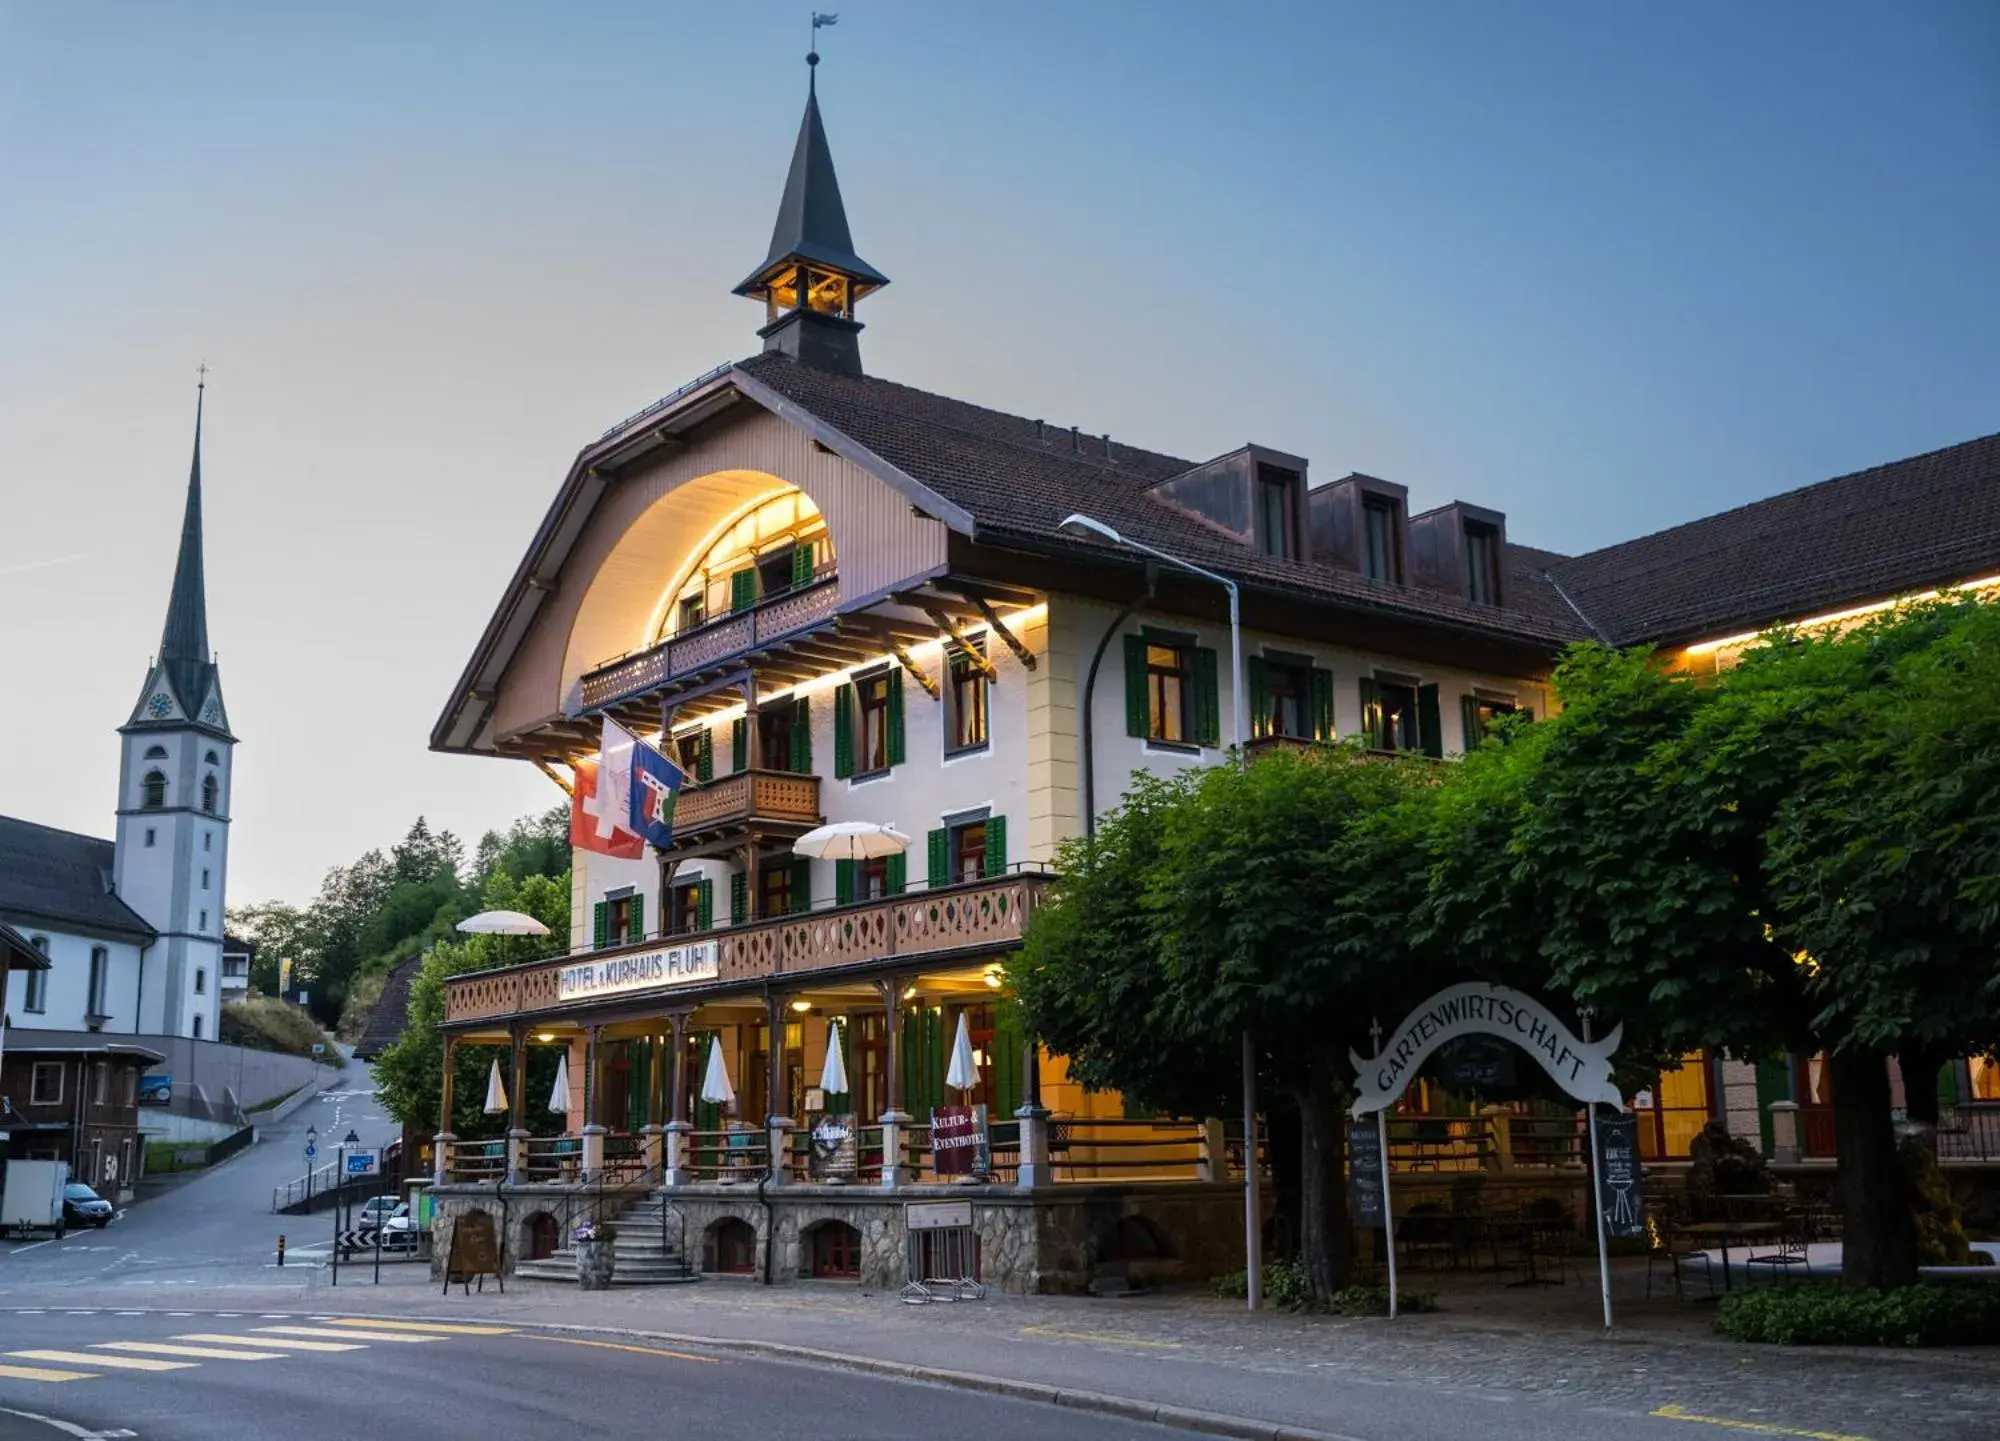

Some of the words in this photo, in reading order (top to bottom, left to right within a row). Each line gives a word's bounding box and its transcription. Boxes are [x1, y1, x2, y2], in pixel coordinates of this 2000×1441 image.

[561, 965, 598, 995] HOTEL
[606, 953, 663, 987] KURHAUS
[1377, 994, 1585, 1092] GARTENWIRTSCHAFT
[935, 1133, 986, 1151] EVENTHOTEL
